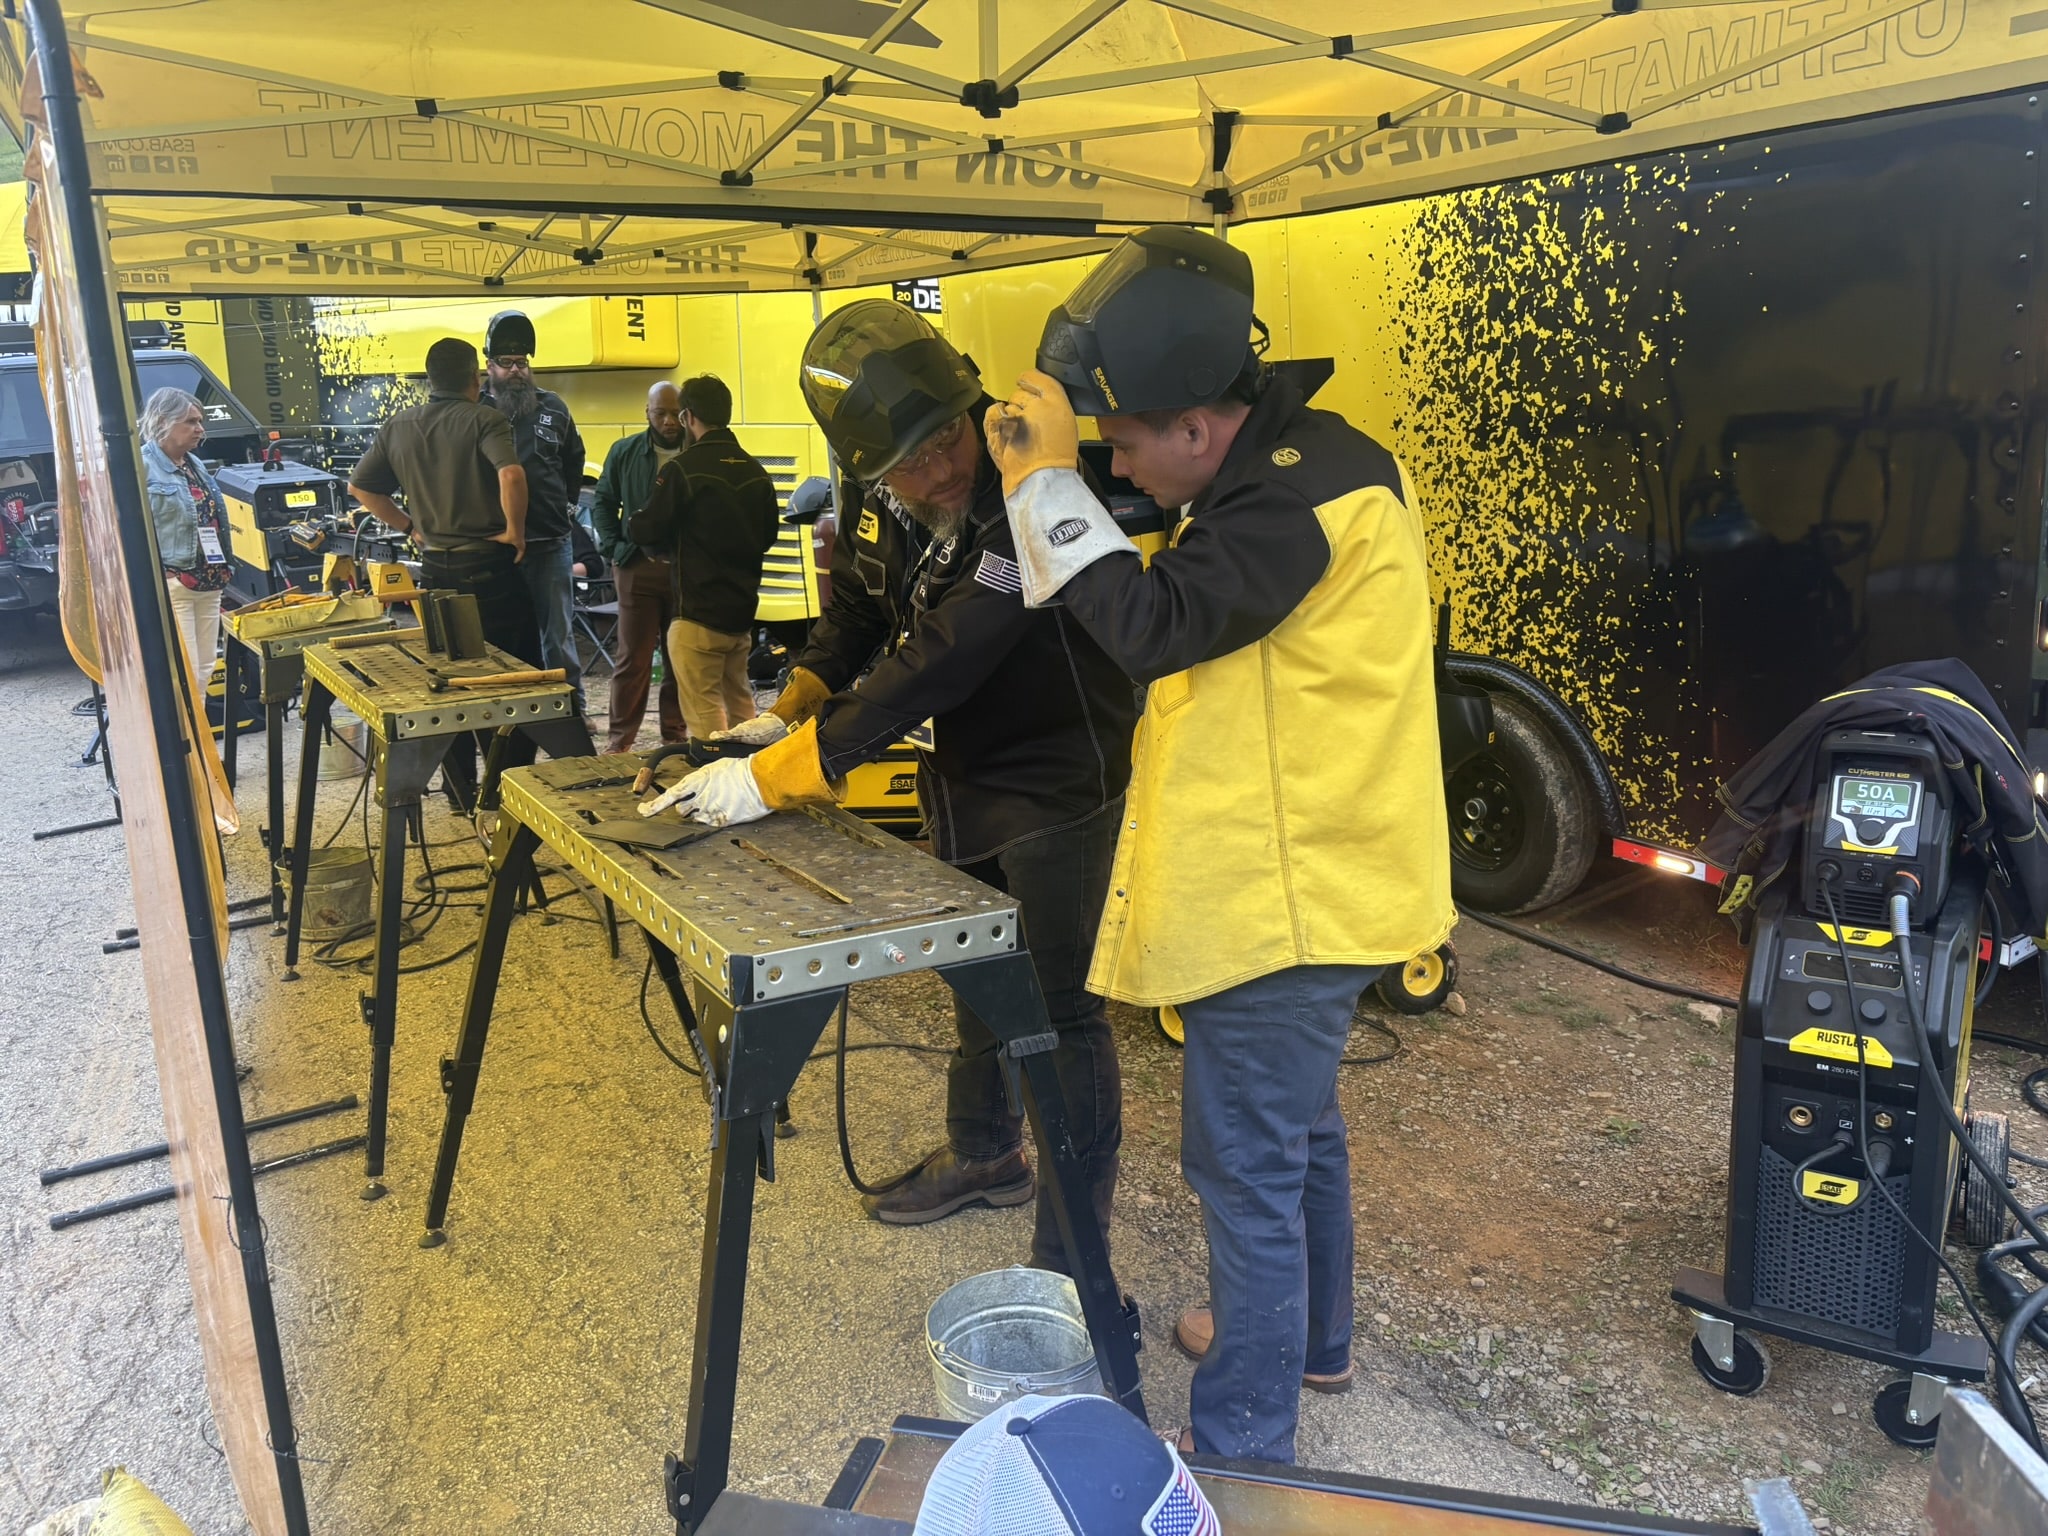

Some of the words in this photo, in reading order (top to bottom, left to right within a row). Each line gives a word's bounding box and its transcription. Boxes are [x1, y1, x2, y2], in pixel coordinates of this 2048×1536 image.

[896, 291, 912, 302] 20
[912, 287, 942, 310] DE
[1094, 367, 1118, 410] SAVAGE
[292, 494, 310, 503] 150
[1049, 520, 1090, 546] IRONCAT
[1848, 768, 1895, 778] CUTMASTER
[1857, 784, 1895, 801] 50A
[1817, 1031, 1869, 1049] RUSTLER
[1816, 1063, 1829, 1071] EM
